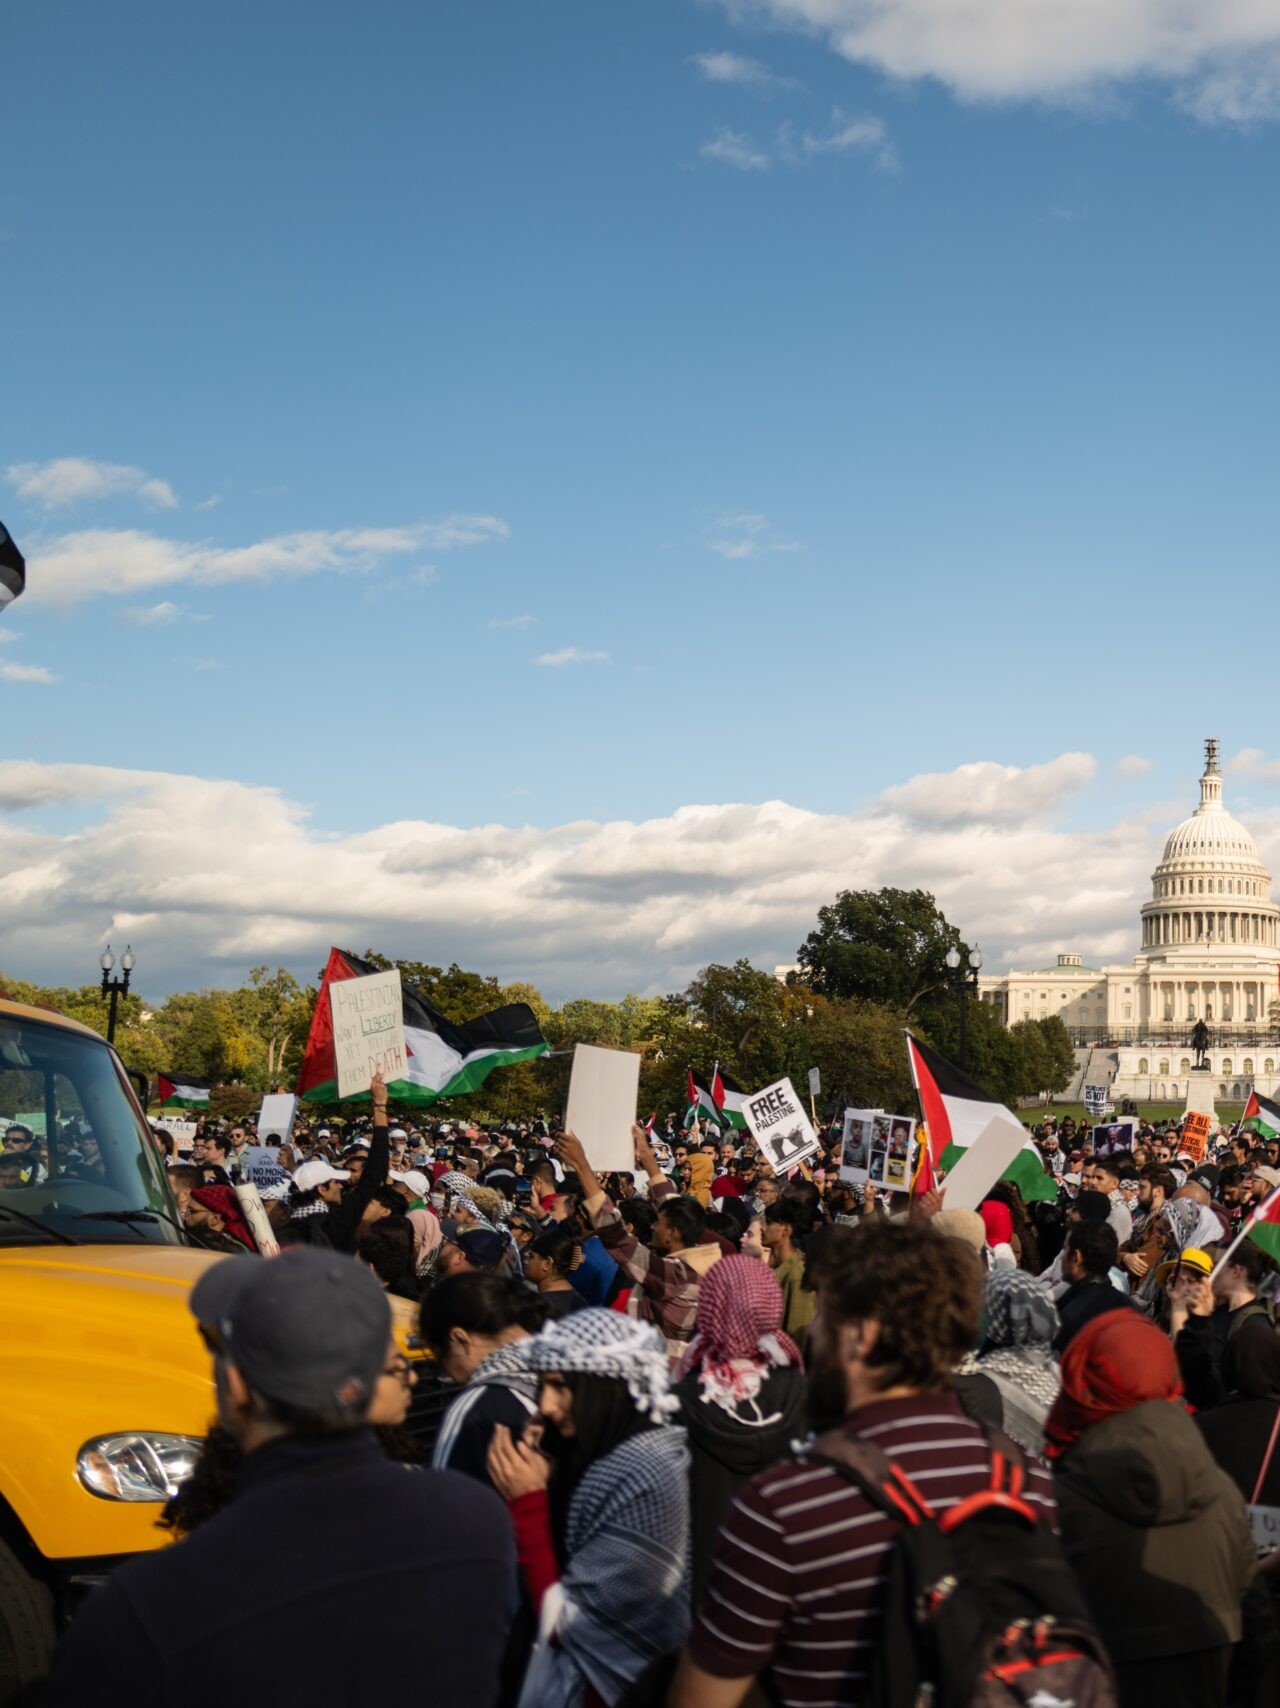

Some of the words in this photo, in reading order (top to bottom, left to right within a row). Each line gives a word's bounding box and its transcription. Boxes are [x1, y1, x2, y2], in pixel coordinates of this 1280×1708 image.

[337, 984, 402, 1016] PALESTINIAN
[336, 1024, 357, 1043] WANT
[360, 1013, 397, 1034] LIBERTY
[344, 1042, 360, 1060] YET
[367, 1036, 383, 1050] YOU
[343, 1065, 366, 1086] THEM
[368, 1046, 403, 1079] DEATH
[749, 1086, 789, 1121] FREE
[1086, 1091, 1092, 1100] IS
[1093, 1091, 1105, 1101] NOT
[755, 1103, 797, 1132] PALESTINE
[1195, 1116, 1208, 1128] ALL
[265, 1168, 287, 1177] MORE
